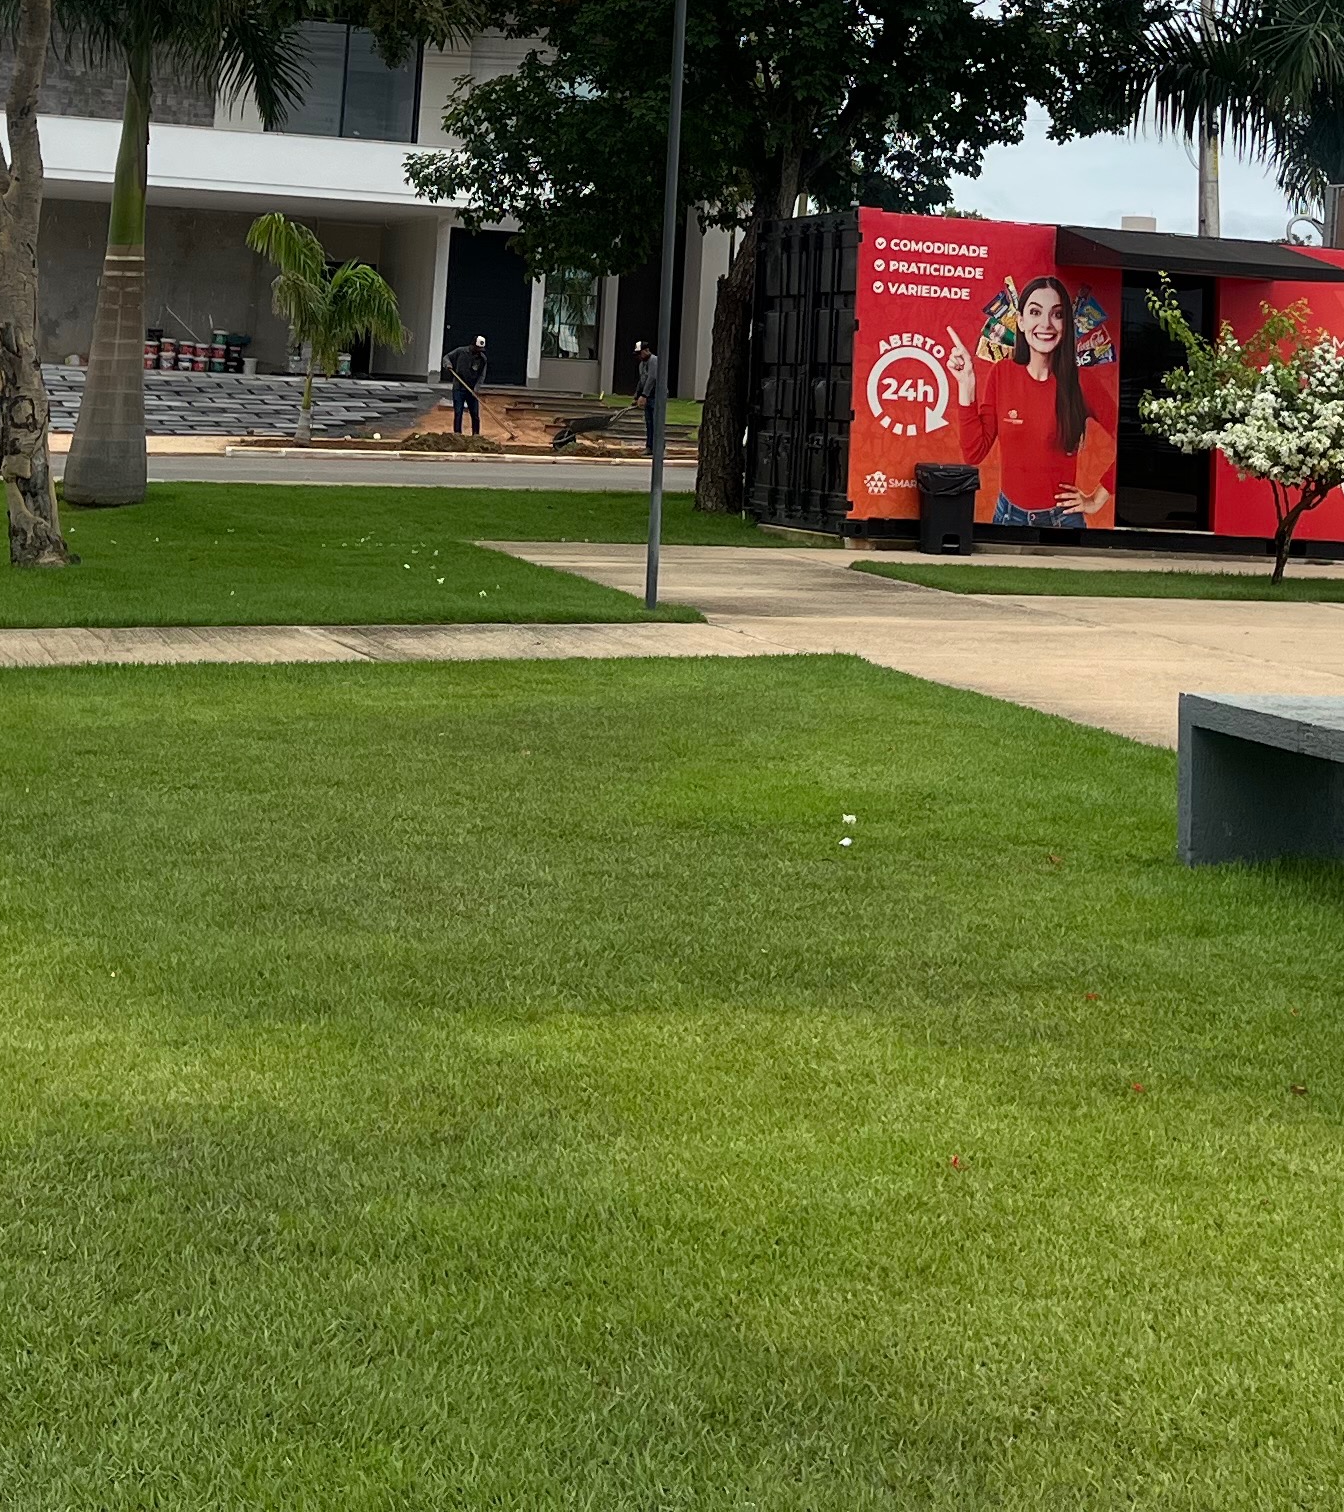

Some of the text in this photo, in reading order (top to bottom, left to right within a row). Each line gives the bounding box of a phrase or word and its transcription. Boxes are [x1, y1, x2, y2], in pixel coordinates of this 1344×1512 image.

[889, 238, 989, 258] COMODIDADE
[888, 260, 985, 280] PRATICIDADE
[887, 281, 971, 300] VARIEDADE
[878, 332, 946, 359] ABERTO
[881, 377, 935, 403] 24h
